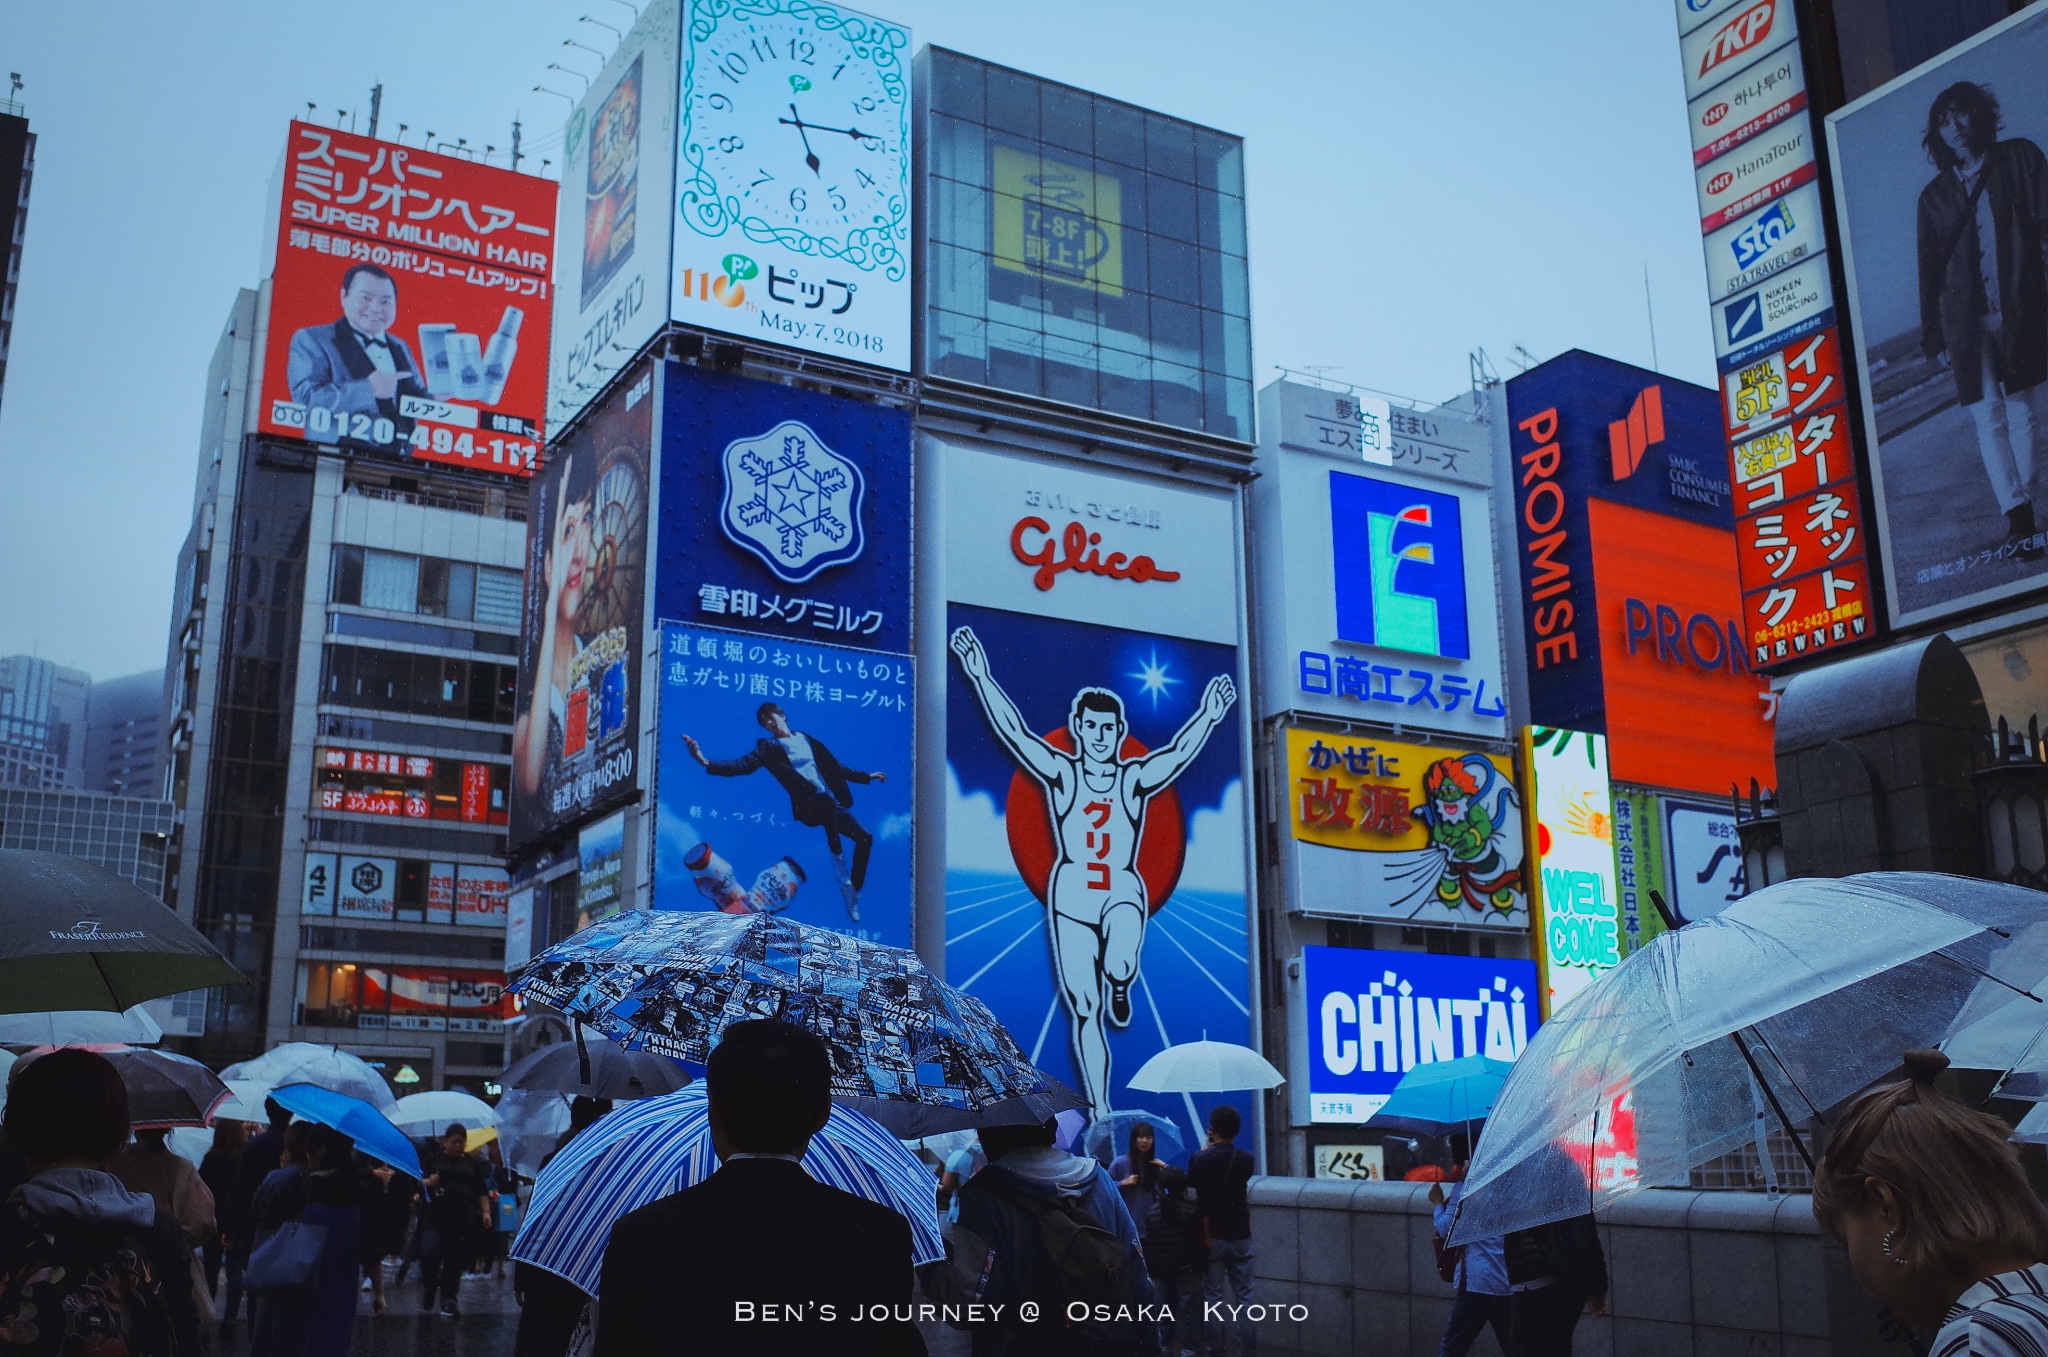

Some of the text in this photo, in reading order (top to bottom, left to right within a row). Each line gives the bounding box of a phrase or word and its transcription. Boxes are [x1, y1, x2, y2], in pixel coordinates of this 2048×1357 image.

[751, 36, 777, 62] 11
[787, 38, 815, 65] 12
[1706, 4, 1772, 69] TKP
[718, 52, 748, 83] 10
[832, 63, 846, 80] 1
[1735, 63, 1791, 105] 하나투어
[709, 93, 733, 113] 9
[852, 97, 875, 115] 2
[297, 129, 443, 182] スーパー
[719, 136, 744, 153] 8
[862, 137, 885, 154] 3
[1736, 135, 1802, 179] HanaTour
[294, 164, 549, 236] ミリオンヘアー
[751, 169, 774, 188] 7
[827, 186, 846, 211] 5
[855, 168, 876, 189] 4
[791, 189, 806, 212] 6
[291, 200, 548, 271] SUPER MILLION HAIR
[1028, 209, 1082, 241] 7-8F
[1737, 217, 1786, 263] sta
[1750, 253, 1789, 282] TRAVEL
[1765, 278, 1802, 300] NIKKEN
[769, 265, 857, 314] ピップ
[1767, 293, 1798, 311] TOTAL
[1768, 292, 1819, 322] SOURCING
[761, 310, 809, 340] May.
[834, 327, 884, 353] 2018
[406, 401, 451, 418] ルアン
[1736, 375, 1782, 421] 5F
[310, 406, 537, 469] 0120-494-111
[1788, 334, 1856, 609] インターネット
[1671, 482, 1720, 507] FINANCE
[1011, 516, 1181, 591] Glico
[1518, 407, 1577, 669] PROMISE
[1746, 472, 1798, 627] コミック
[1916, 531, 2048, 584] 店舗とオンラインで展
[698, 583, 883, 635] 雪印メグミルク
[670, 633, 906, 686] 道頓堀のおいしいものと
[668, 662, 906, 712] 恵ガセリ菌SP株ヨーグルト
[1300, 650, 1505, 717] 日商エステム
[1307, 740, 1400, 778] かぜに
[323, 791, 343, 808] 5F
[1297, 777, 1413, 835] 改源
[1083, 797, 1113, 892] グリコ
[1544, 867, 1617, 917] WEL
[1549, 915, 1619, 965] COME
